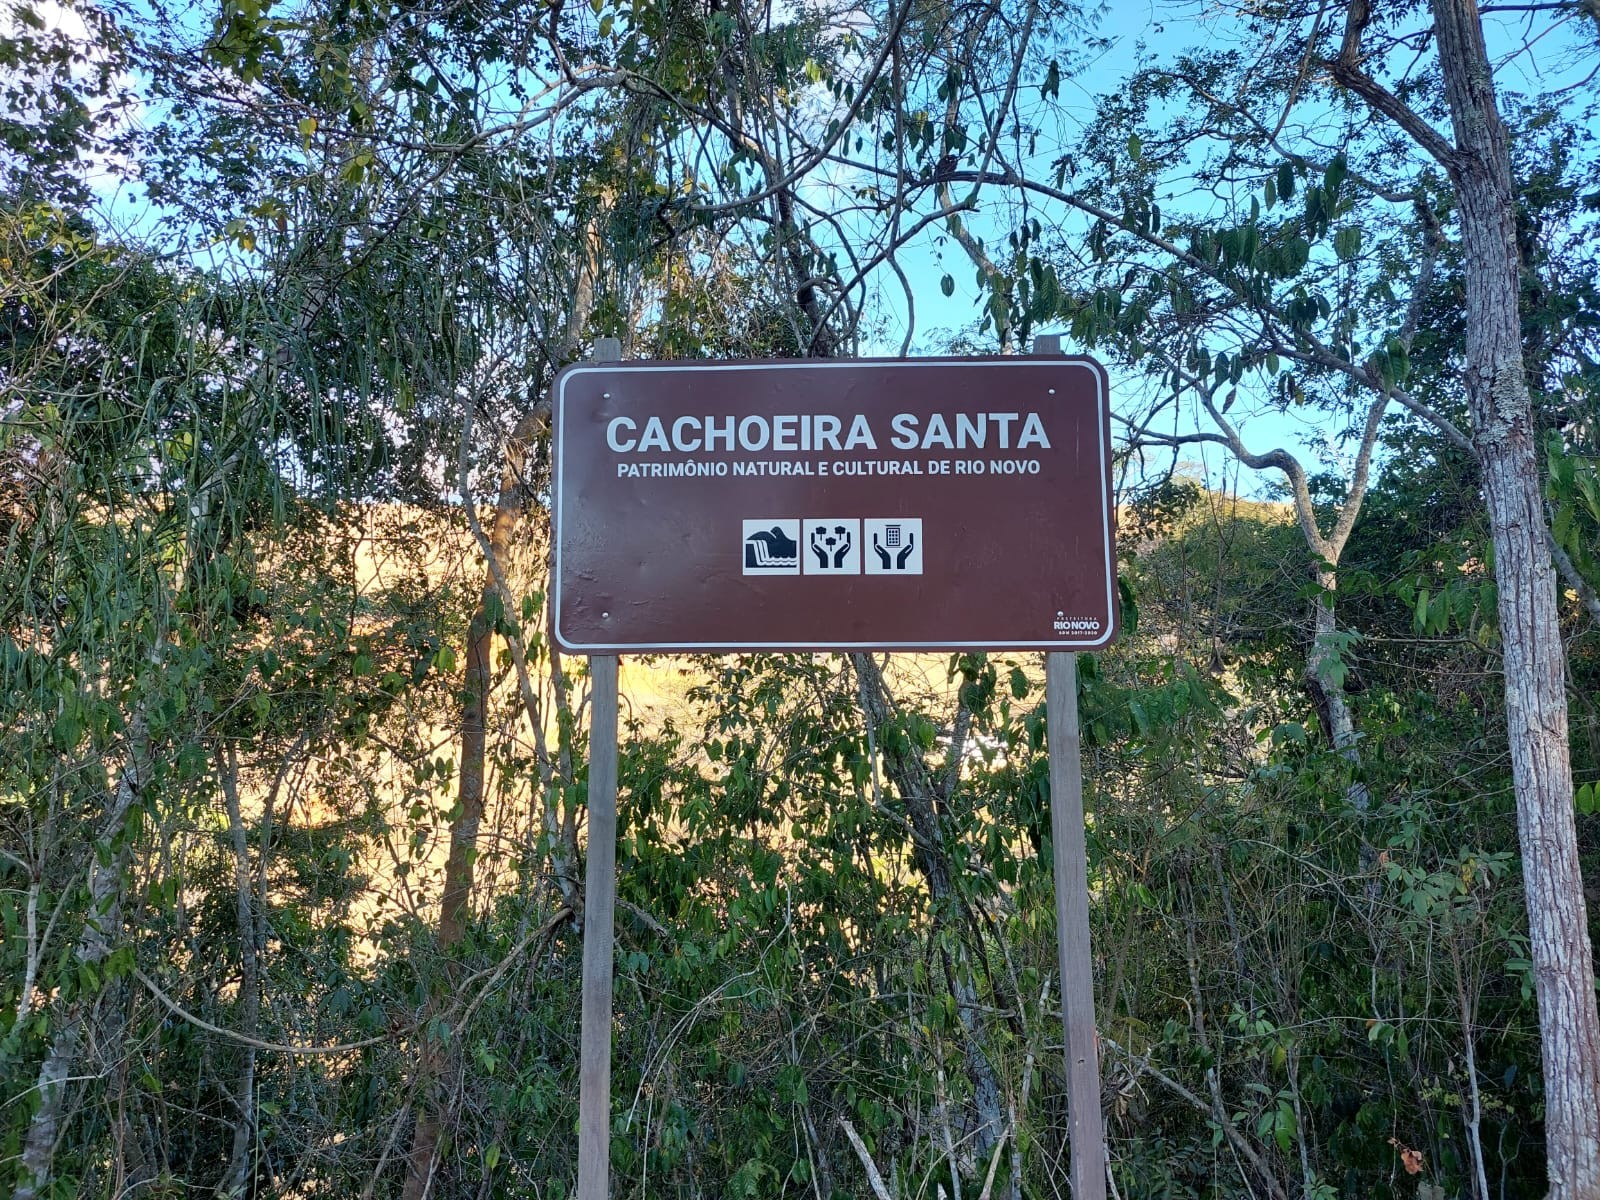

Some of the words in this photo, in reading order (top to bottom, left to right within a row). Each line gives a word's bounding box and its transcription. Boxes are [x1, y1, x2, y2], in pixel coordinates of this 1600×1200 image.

[606, 414, 878, 453] CACHOEIRA
[890, 412, 1051, 450] SANTA
[617, 459, 728, 477] PATRIMÔNIO
[732, 461, 815, 476] NATURAL
[818, 461, 829, 475] E
[832, 460, 924, 476] CULTURAL
[928, 460, 951, 475] DE
[955, 459, 986, 475] RIO
[990, 459, 1041, 475] NOVO
[1053, 620, 1071, 630] RIO
[1071, 620, 1101, 630] NOVO
